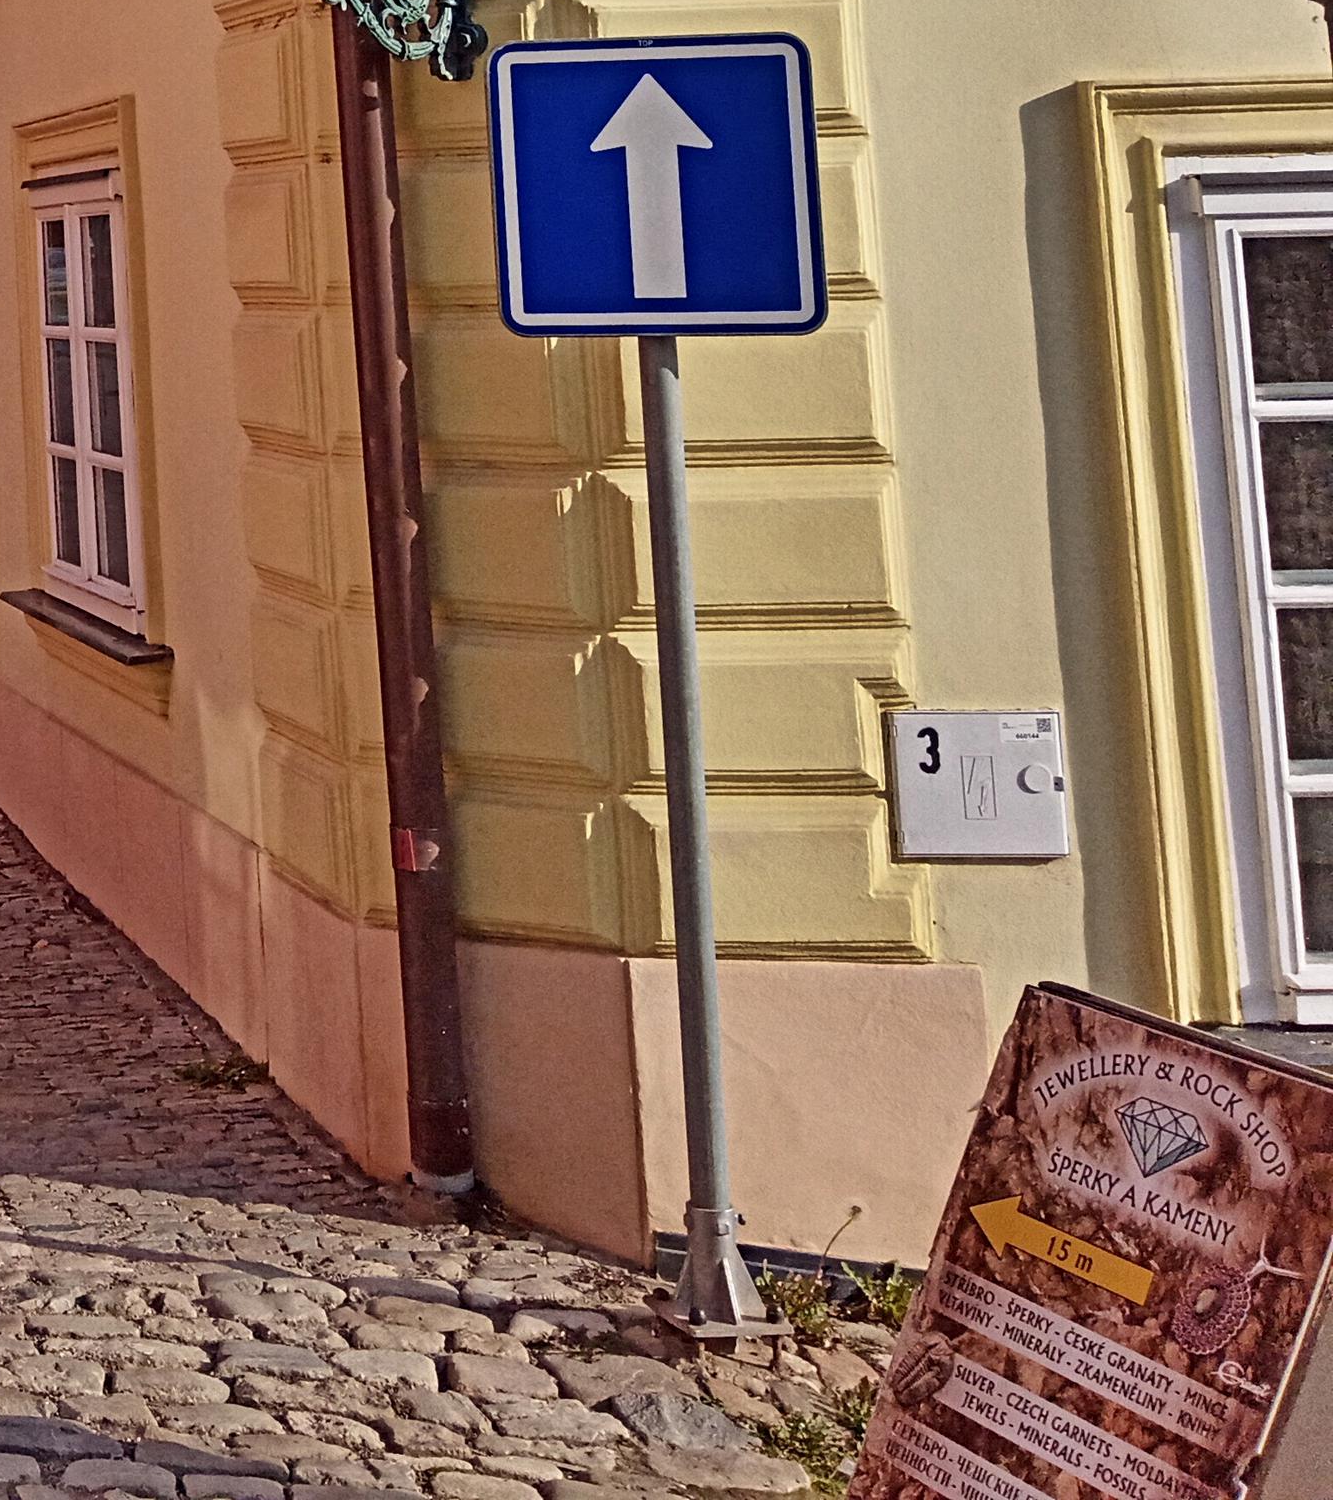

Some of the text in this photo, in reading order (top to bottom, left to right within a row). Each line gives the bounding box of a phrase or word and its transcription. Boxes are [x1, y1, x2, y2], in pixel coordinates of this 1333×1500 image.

[917, 726, 941, 775] 3
[1034, 1053, 1286, 1179] JEWELLERY & ROCK SHOP
[1047, 1146, 1237, 1247] ŠPERKY A KAMENY
[1045, 1234, 1094, 1273] 15 m
[1001, 1321, 1064, 1368] MINERÁLY
[1005, 1296, 1054, 1336] ŠPERKY
[1063, 1326, 1106, 1361] ČESKÉ
[1107, 1350, 1174, 1394] GRANÁTY
[955, 1363, 995, 1398] SILVER
[1005, 1391, 1050, 1426] CZECH
[1051, 1415, 1113, 1460] GARNETS
[961, 1392, 1147, 1500] JEWELS MINERALS FOSSILS
